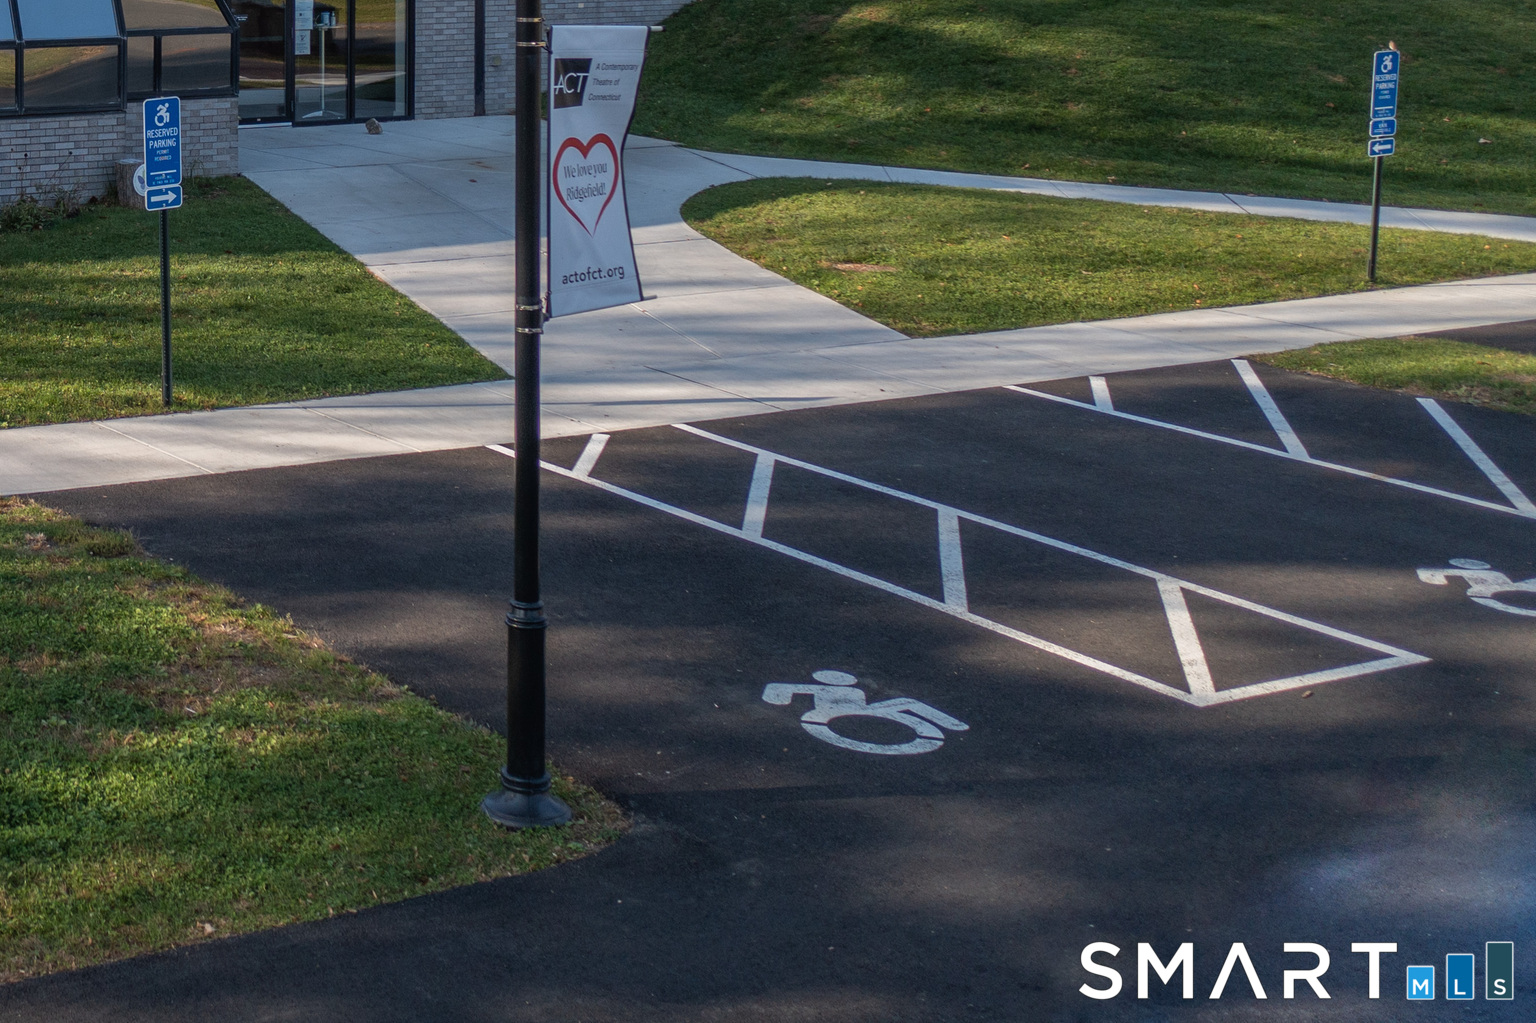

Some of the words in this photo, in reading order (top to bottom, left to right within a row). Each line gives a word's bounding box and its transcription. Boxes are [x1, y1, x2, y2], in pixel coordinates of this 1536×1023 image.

[601, 63, 639, 72] Contemporary
[553, 72, 590, 94] ACT
[593, 78, 613, 86] Theatre
[614, 78, 621, 86] of
[1375, 81, 1395, 90] PARKING
[588, 93, 622, 101] Connecticut
[146, 127, 179, 138] RESERVED
[149, 138, 177, 149] PARKING
[563, 165, 576, 179] We
[576, 163, 592, 177] love
[593, 162, 608, 178] you
[566, 182, 607, 203] Ridgefield!
[561, 265, 625, 285] actofct.org
